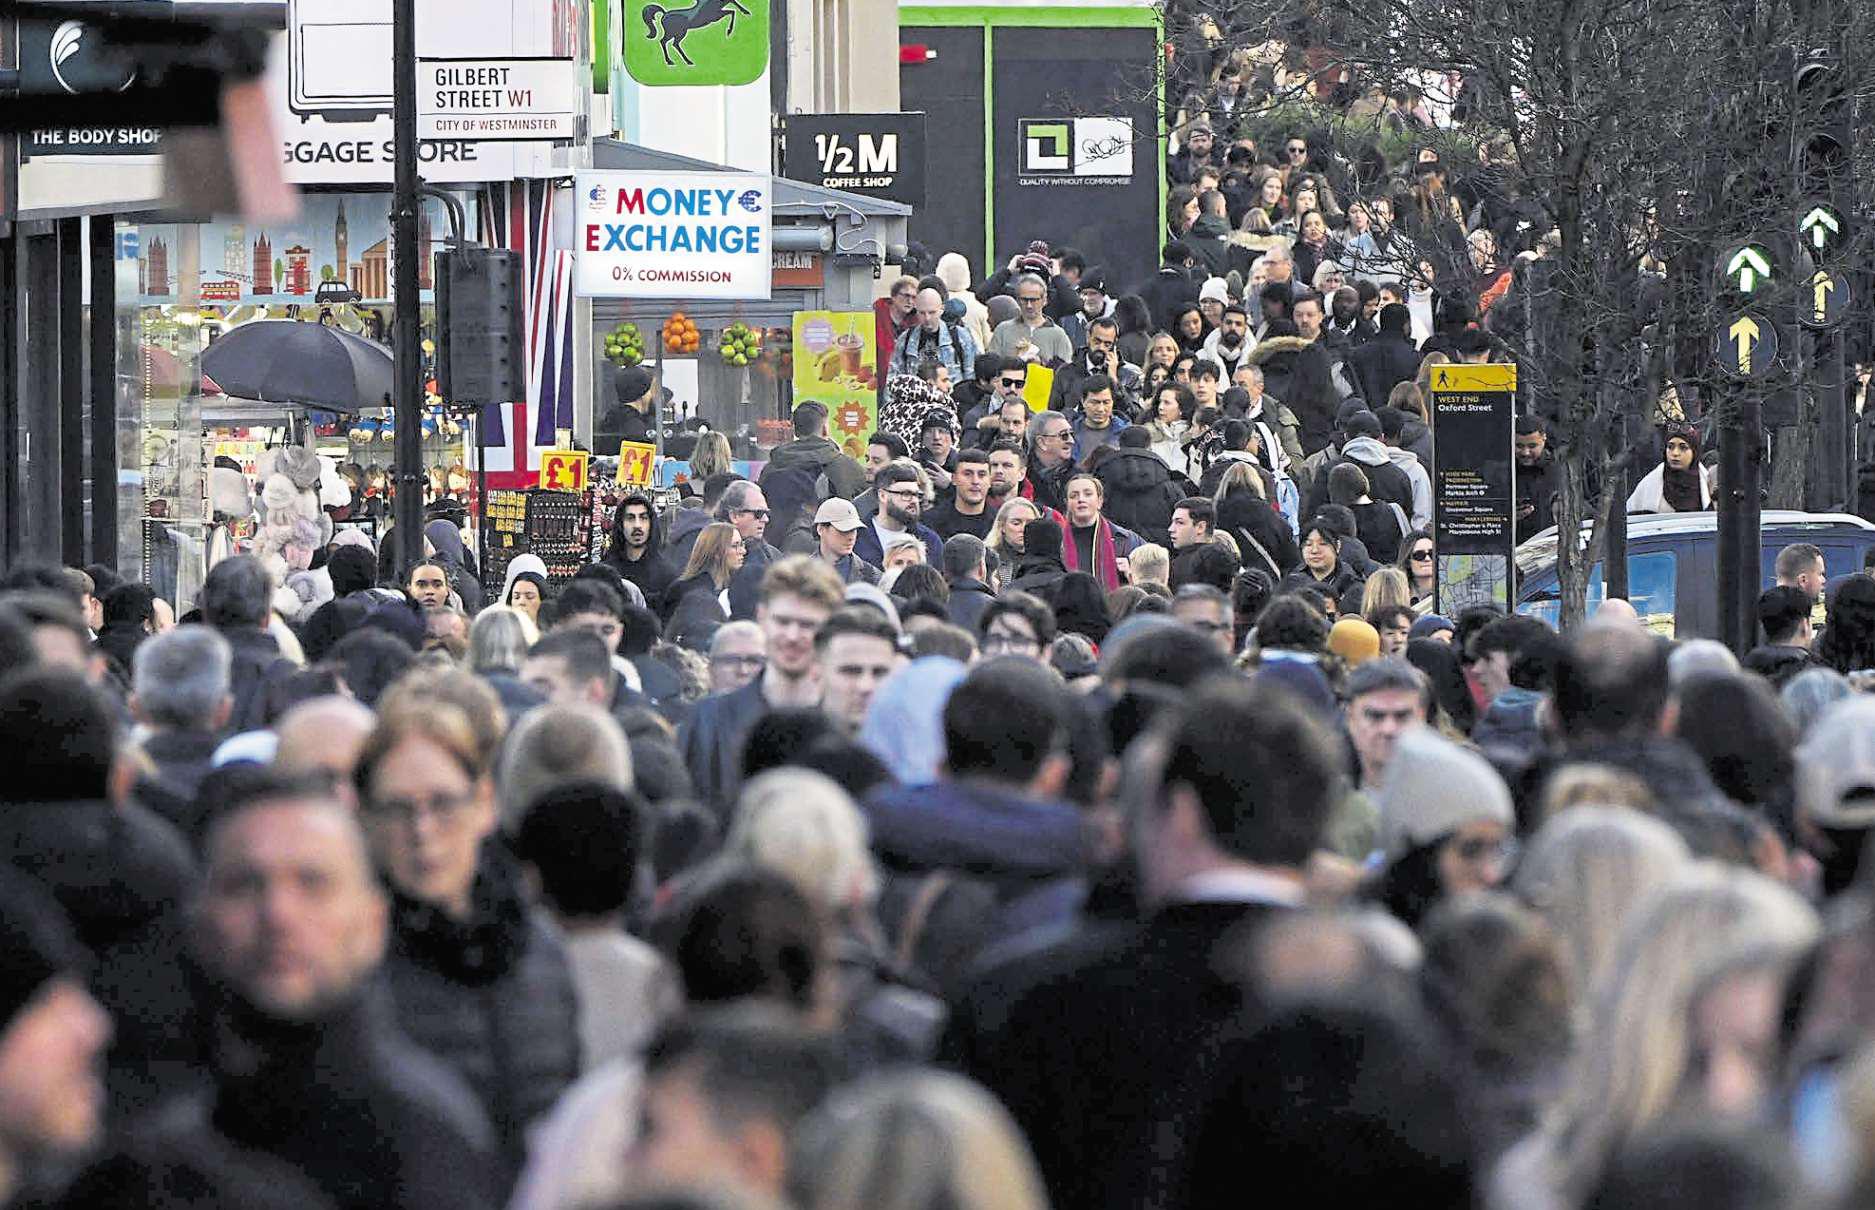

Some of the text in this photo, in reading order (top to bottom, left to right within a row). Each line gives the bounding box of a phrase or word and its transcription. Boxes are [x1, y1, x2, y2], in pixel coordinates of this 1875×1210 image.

[436, 67, 509, 86] GILBERT
[436, 90, 532, 108] STREET W1
[436, 119, 557, 131] CITY OF WESTMINSTER
[32, 129, 64, 144] THE
[68, 129, 115, 144] BODY
[382, 141, 478, 162] SORE
[823, 177, 893, 188] COFFEE SHOP
[616, 187, 736, 216] MONEY
[586, 224, 760, 254] EXCHANGE
[612, 266, 732, 283] 0% COMMISSION
[1438, 404, 1493, 412] Oxford Street
[546, 457, 582, 489] £1
[620, 448, 651, 481] £1
